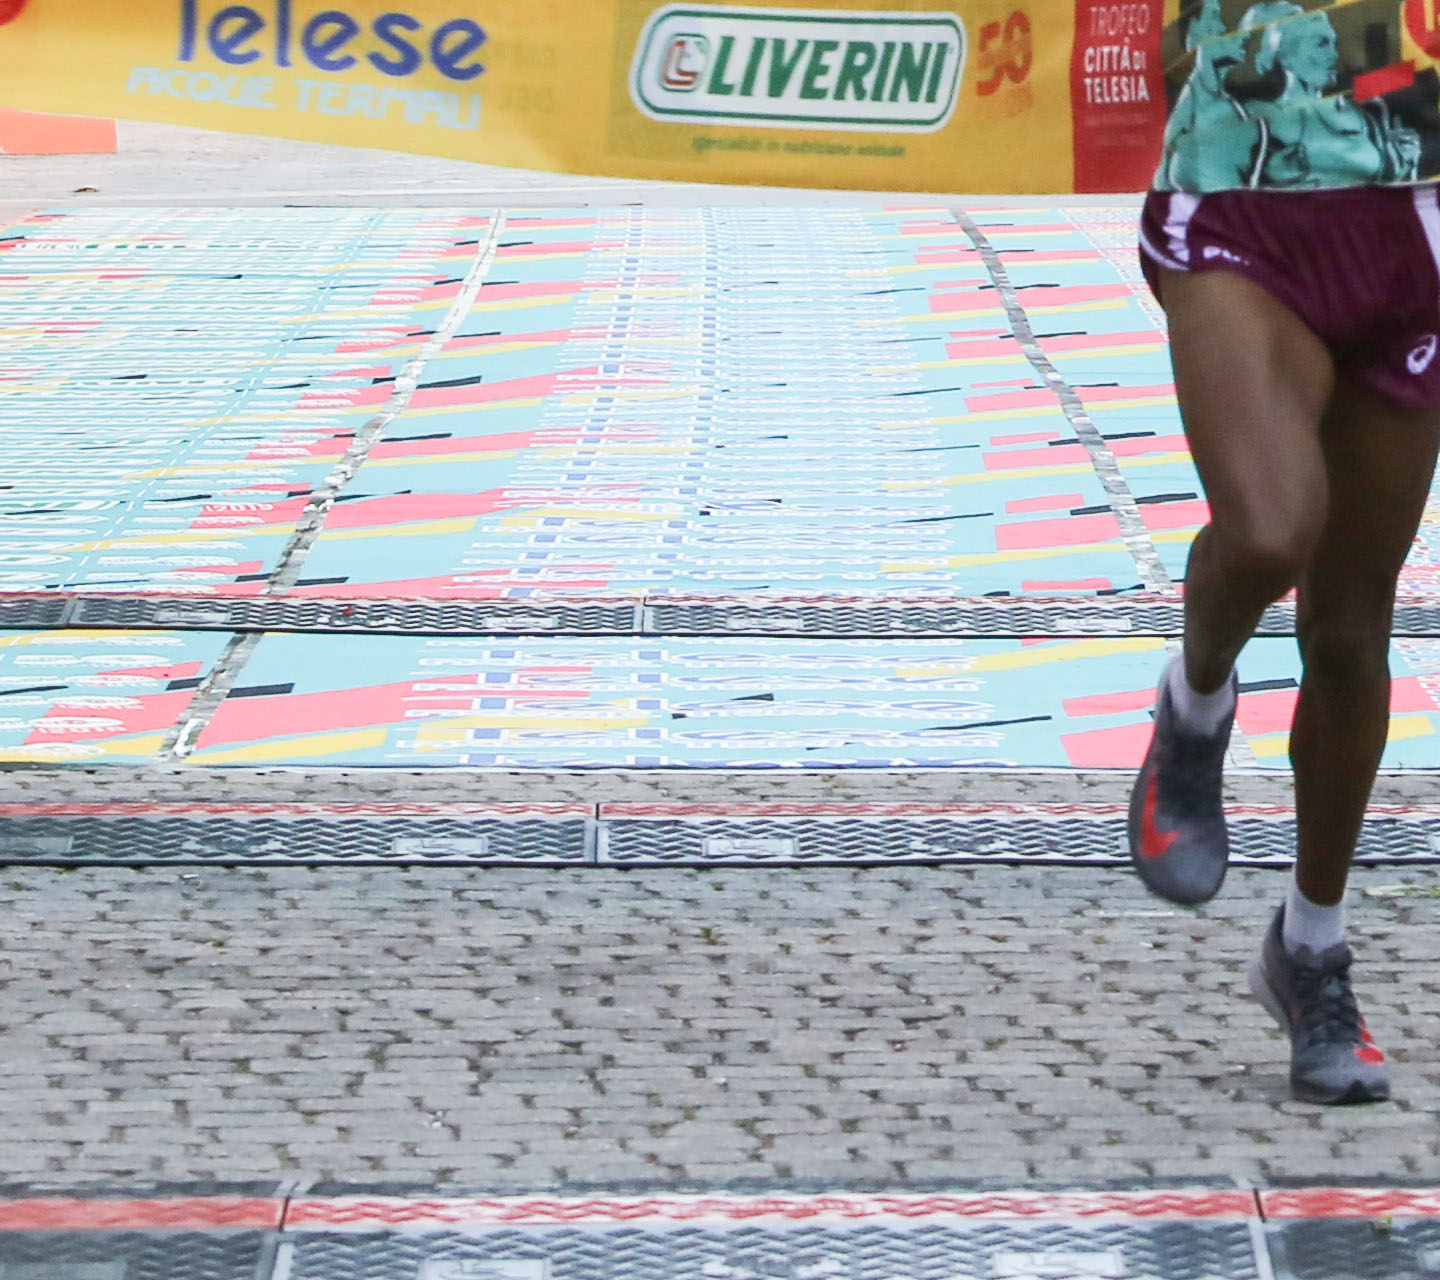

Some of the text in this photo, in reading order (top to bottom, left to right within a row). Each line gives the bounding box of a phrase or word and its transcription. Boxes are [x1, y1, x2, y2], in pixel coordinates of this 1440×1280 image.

[1088, 2, 1152, 39] TROFEO
[707, 34, 950, 105] LIVERINI
[1083, 36, 1133, 75] CITTÀ
[126, 65, 485, 132] ACQUE TERMALI
[1083, 74, 1152, 104] TELESIA
